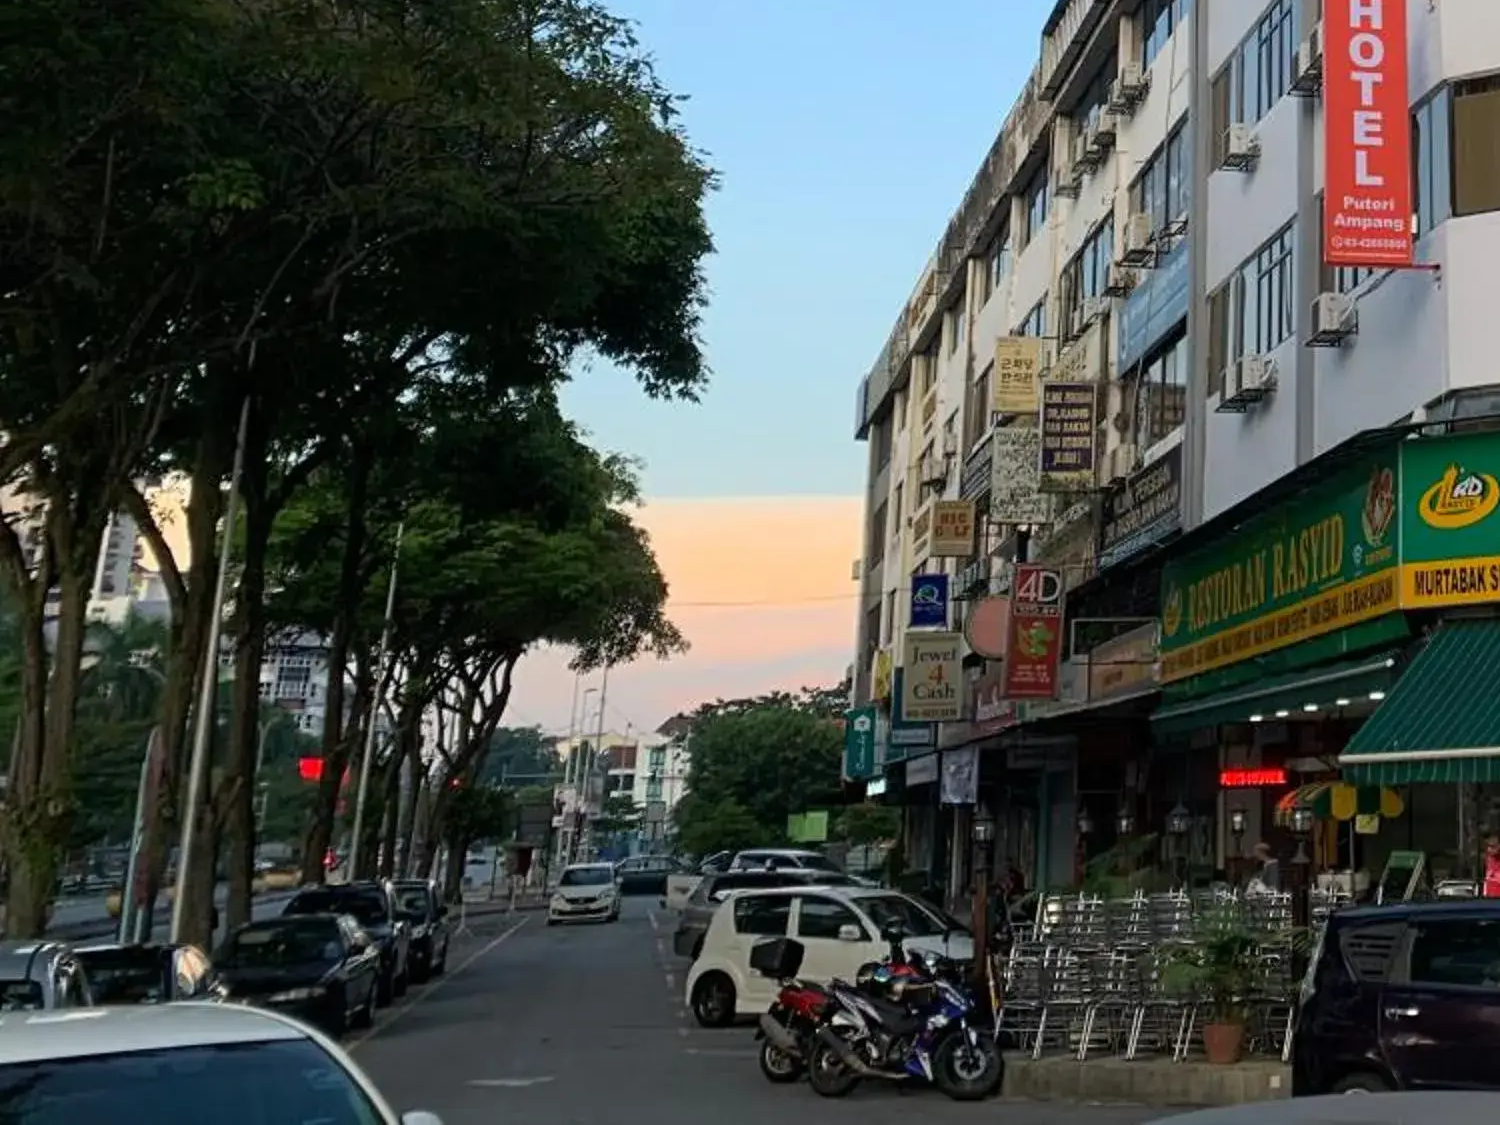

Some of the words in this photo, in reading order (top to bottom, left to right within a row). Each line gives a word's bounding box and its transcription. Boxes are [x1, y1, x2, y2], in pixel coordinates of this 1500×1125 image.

[1343, 195, 1395, 212] Puteri
[1333, 213, 1405, 232] Ampang
[1272, 512, 1344, 599] RASYID
[1018, 571, 1061, 602] 4D
[1414, 565, 1487, 596] MURTABAK
[912, 645, 957, 666] Jewel
[928, 663, 945, 684] 4
[912, 680, 956, 699] Cash
